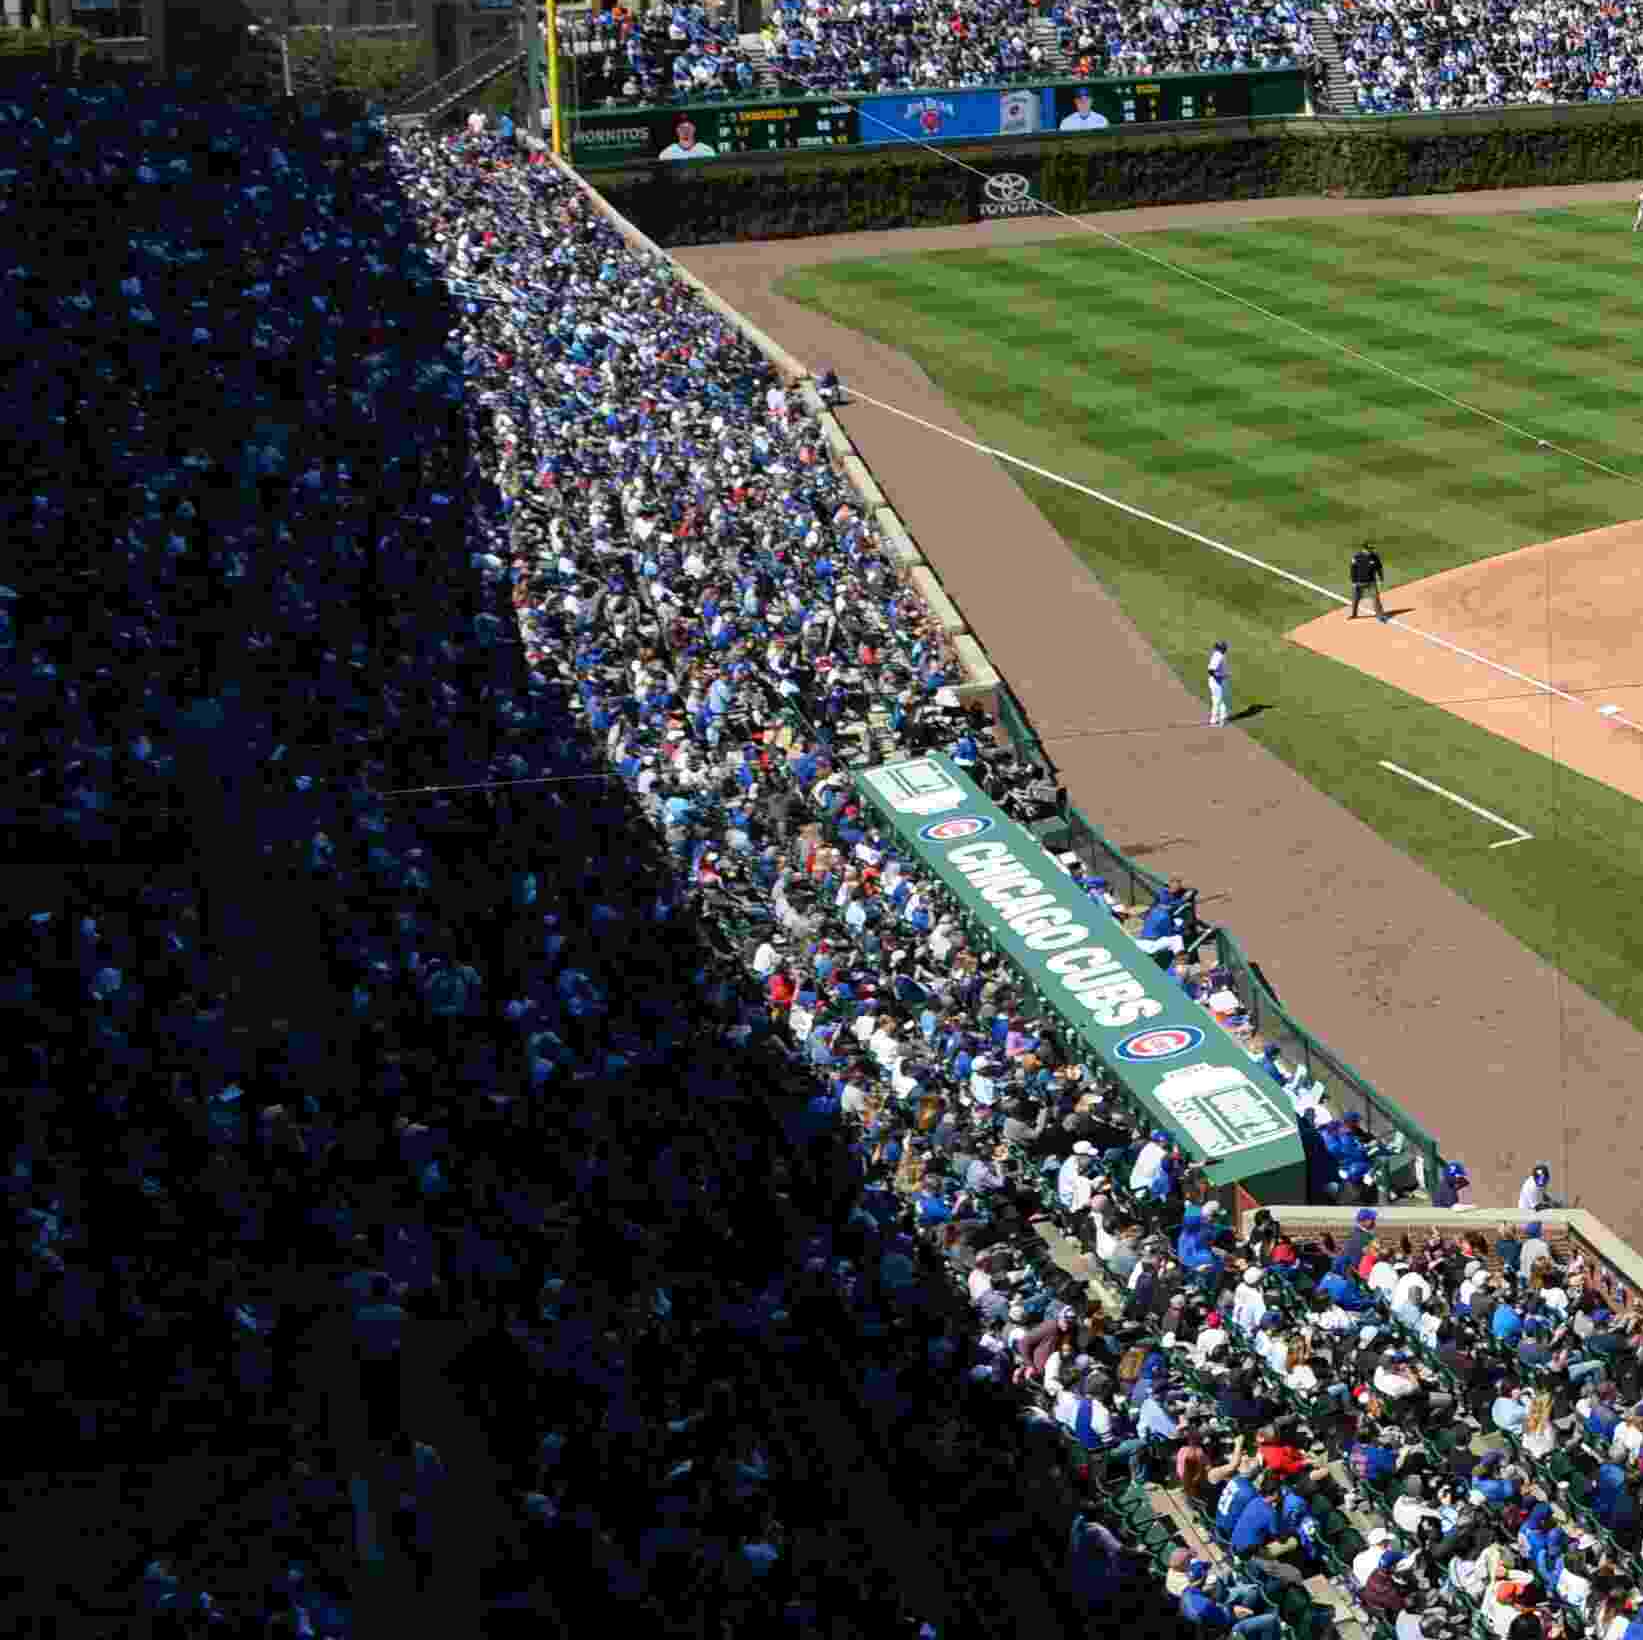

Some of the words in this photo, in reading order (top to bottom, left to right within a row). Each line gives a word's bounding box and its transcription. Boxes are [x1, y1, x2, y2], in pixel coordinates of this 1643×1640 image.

[978, 201, 1039, 215] TOYOTA
[947, 841, 1089, 951] CHICAGO
[1045, 947, 1163, 1028] CUBS
